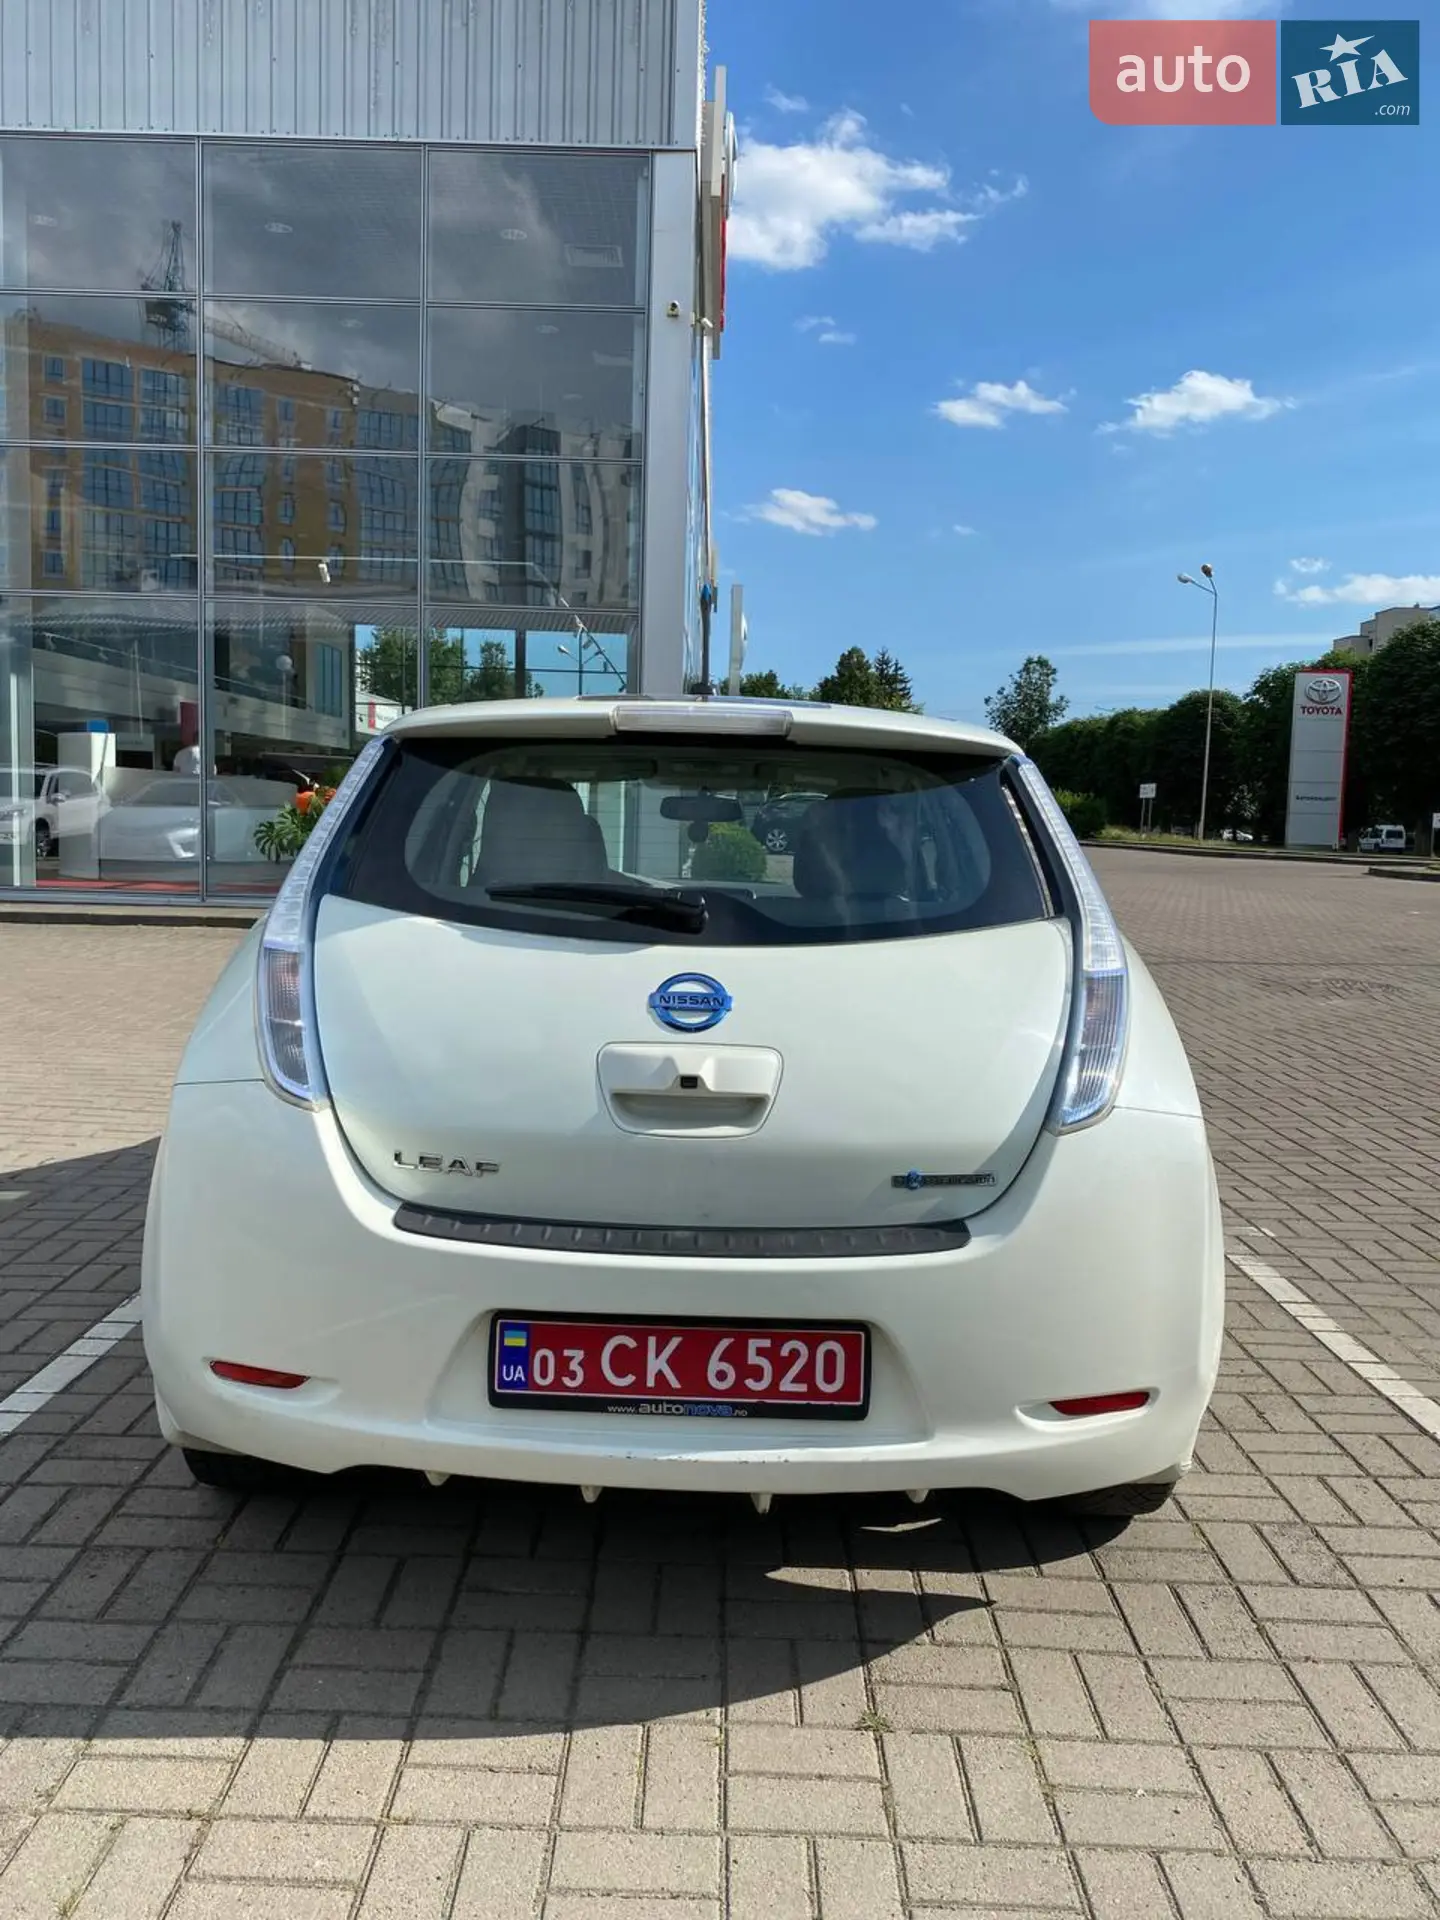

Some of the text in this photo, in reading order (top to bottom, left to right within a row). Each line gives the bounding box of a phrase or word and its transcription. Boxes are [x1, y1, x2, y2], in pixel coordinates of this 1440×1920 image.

[1300, 705, 1343, 716] TOYOTA
[659, 994, 725, 1007] NISSAN
[393, 1151, 500, 1177] LEAF
[532, 1334, 846, 1394] 03 CK 6520
[502, 1365, 526, 1383] UA
[607, 1401, 748, 1417] www.autonova.ro
